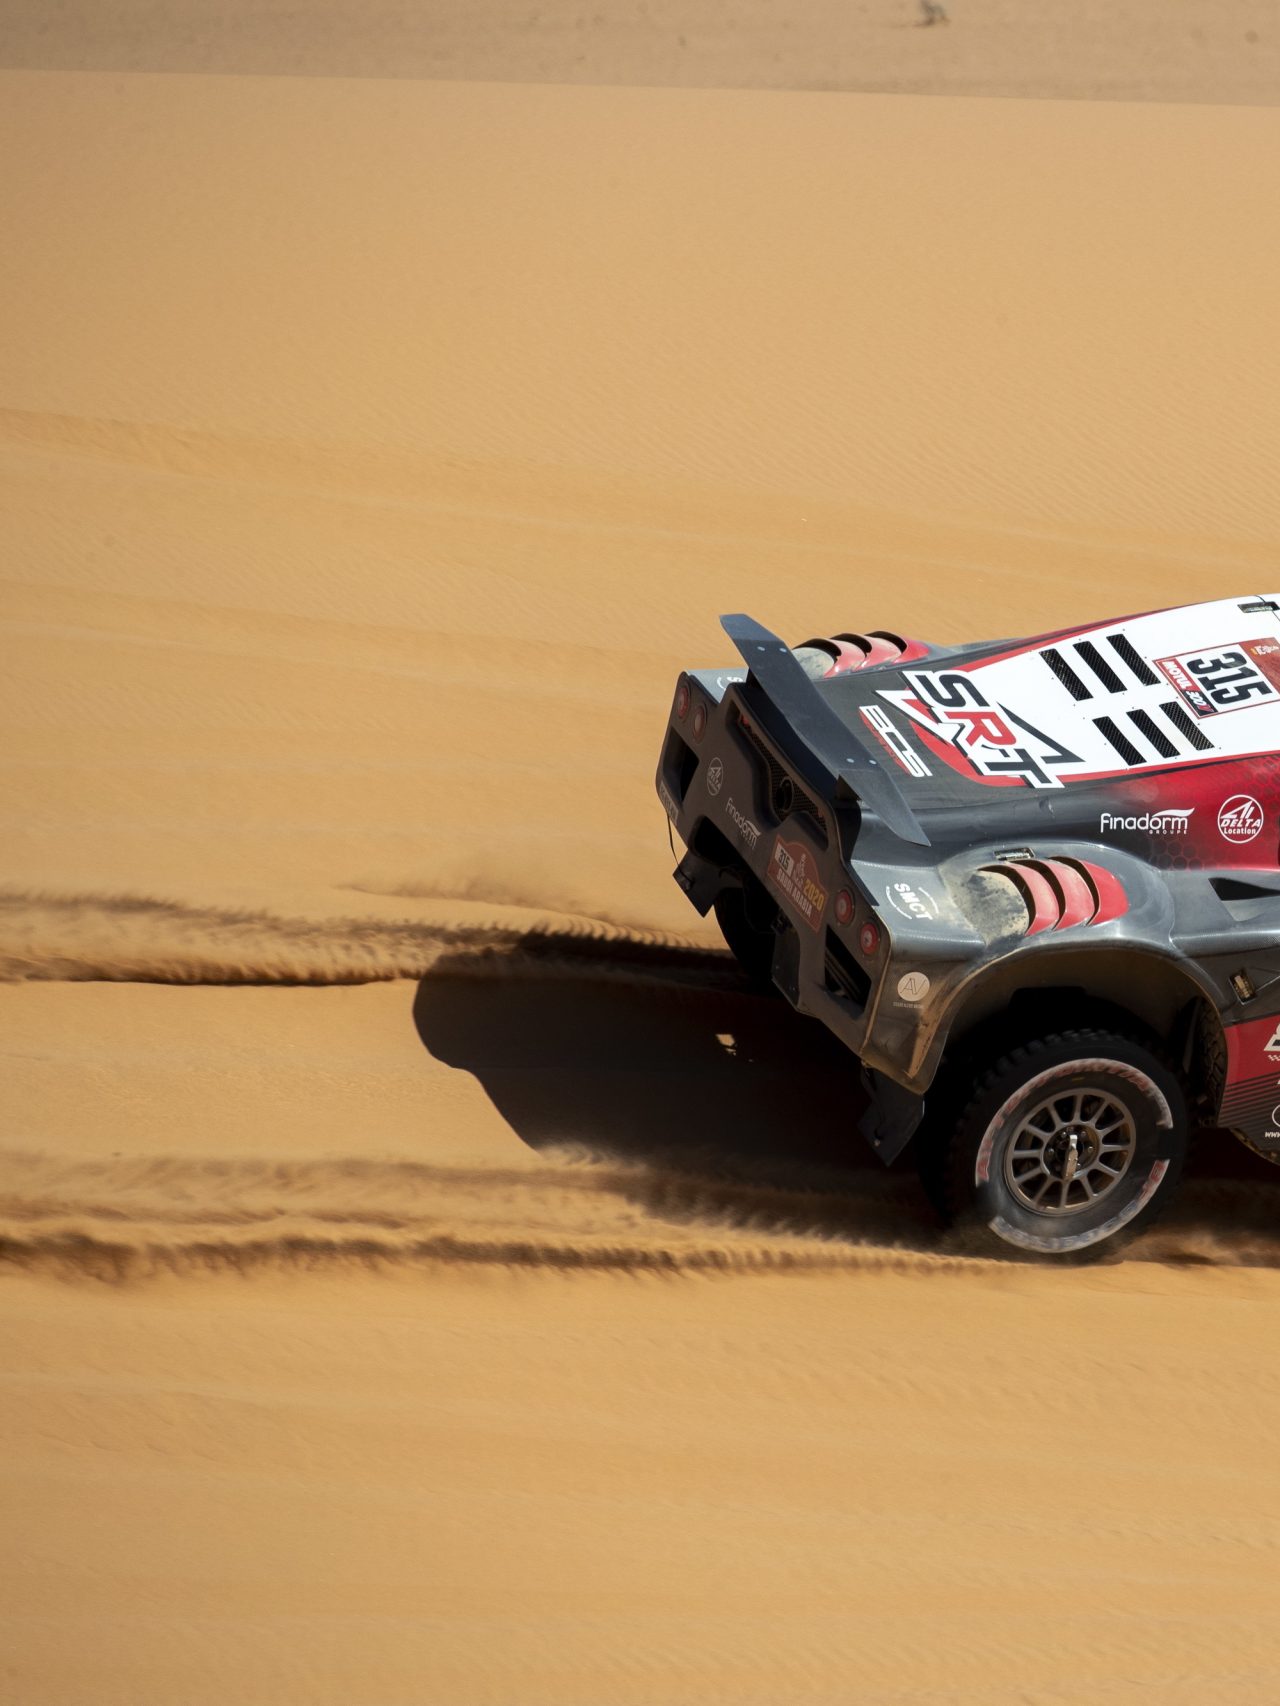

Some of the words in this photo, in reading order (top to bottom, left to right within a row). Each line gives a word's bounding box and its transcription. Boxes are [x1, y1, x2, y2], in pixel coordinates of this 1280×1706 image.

[1161, 660, 1194, 690] MOTUL
[1186, 651, 1273, 705] 315
[902, 670, 1065, 788] SRT
[1220, 819, 1261, 828] DELTA
[792, 886, 813, 918] ARABIA
[803, 879, 825, 911] 2020
